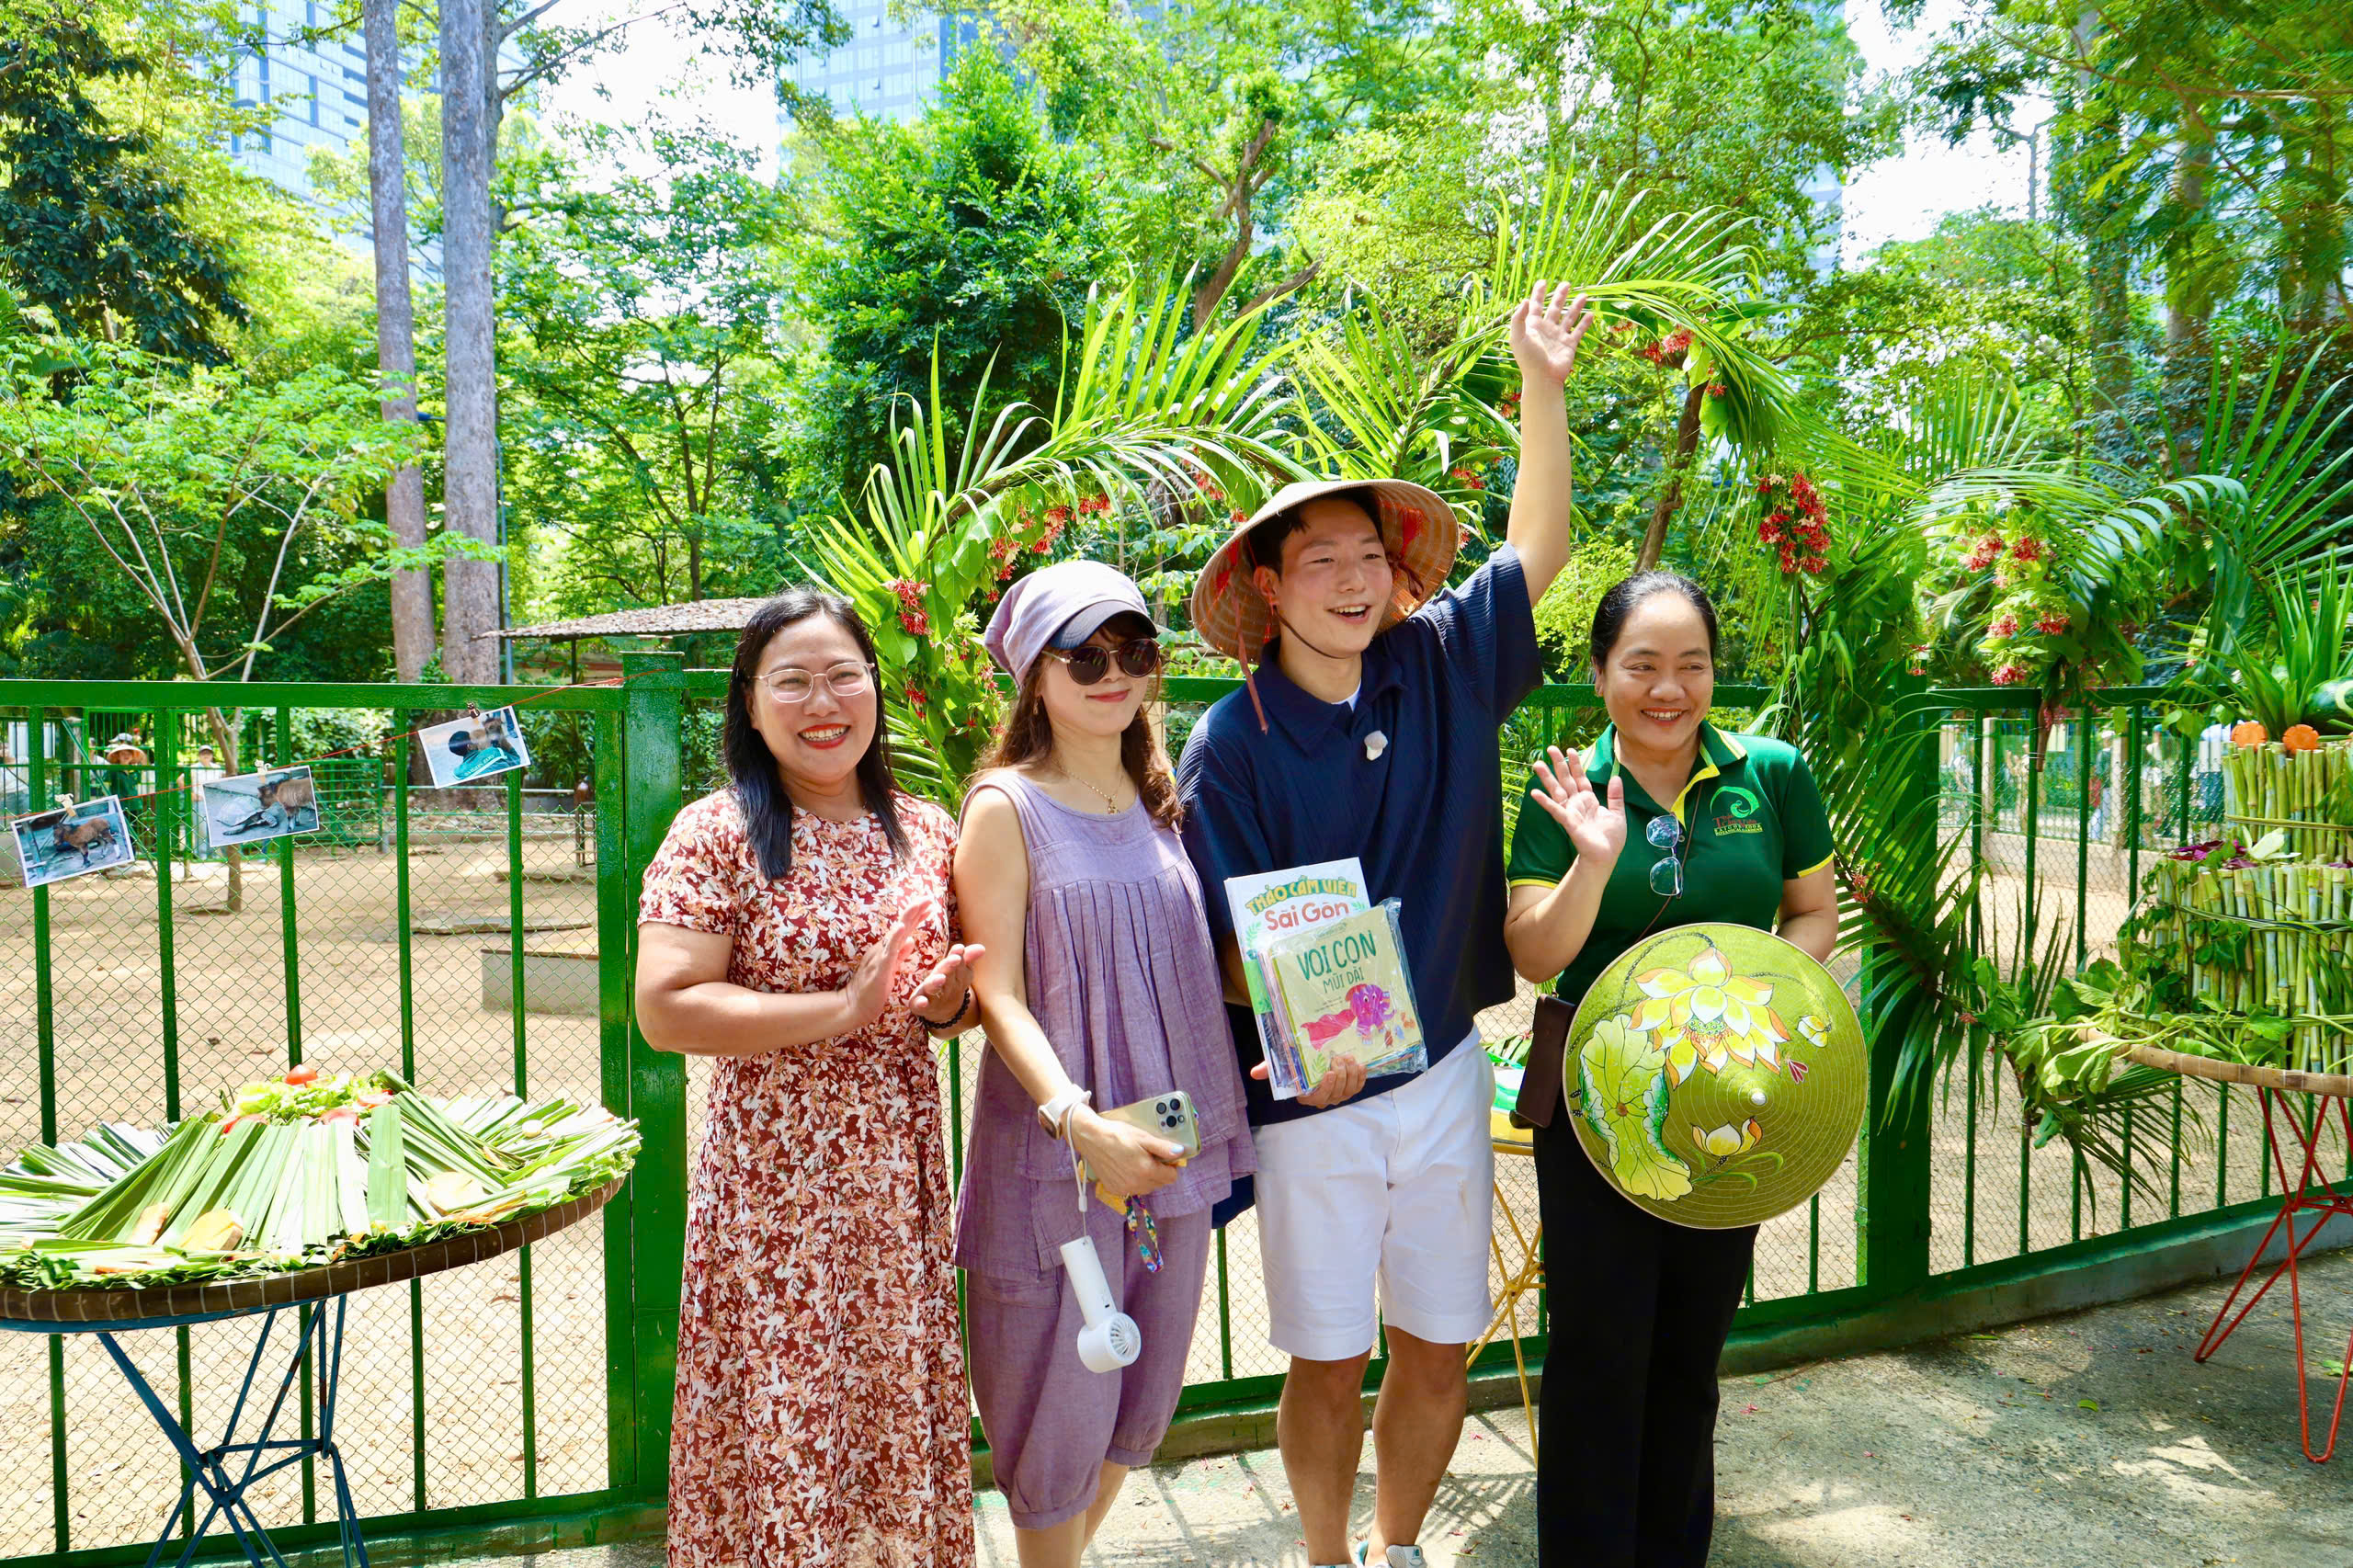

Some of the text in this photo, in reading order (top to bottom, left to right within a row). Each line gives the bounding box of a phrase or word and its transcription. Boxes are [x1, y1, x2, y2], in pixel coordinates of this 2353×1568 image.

[1322, 876, 1358, 898] VIÊN
[1264, 905, 1300, 931] Sài
[1302, 902, 1349, 923] Gòn
[1296, 929, 1376, 981] VOI CON
